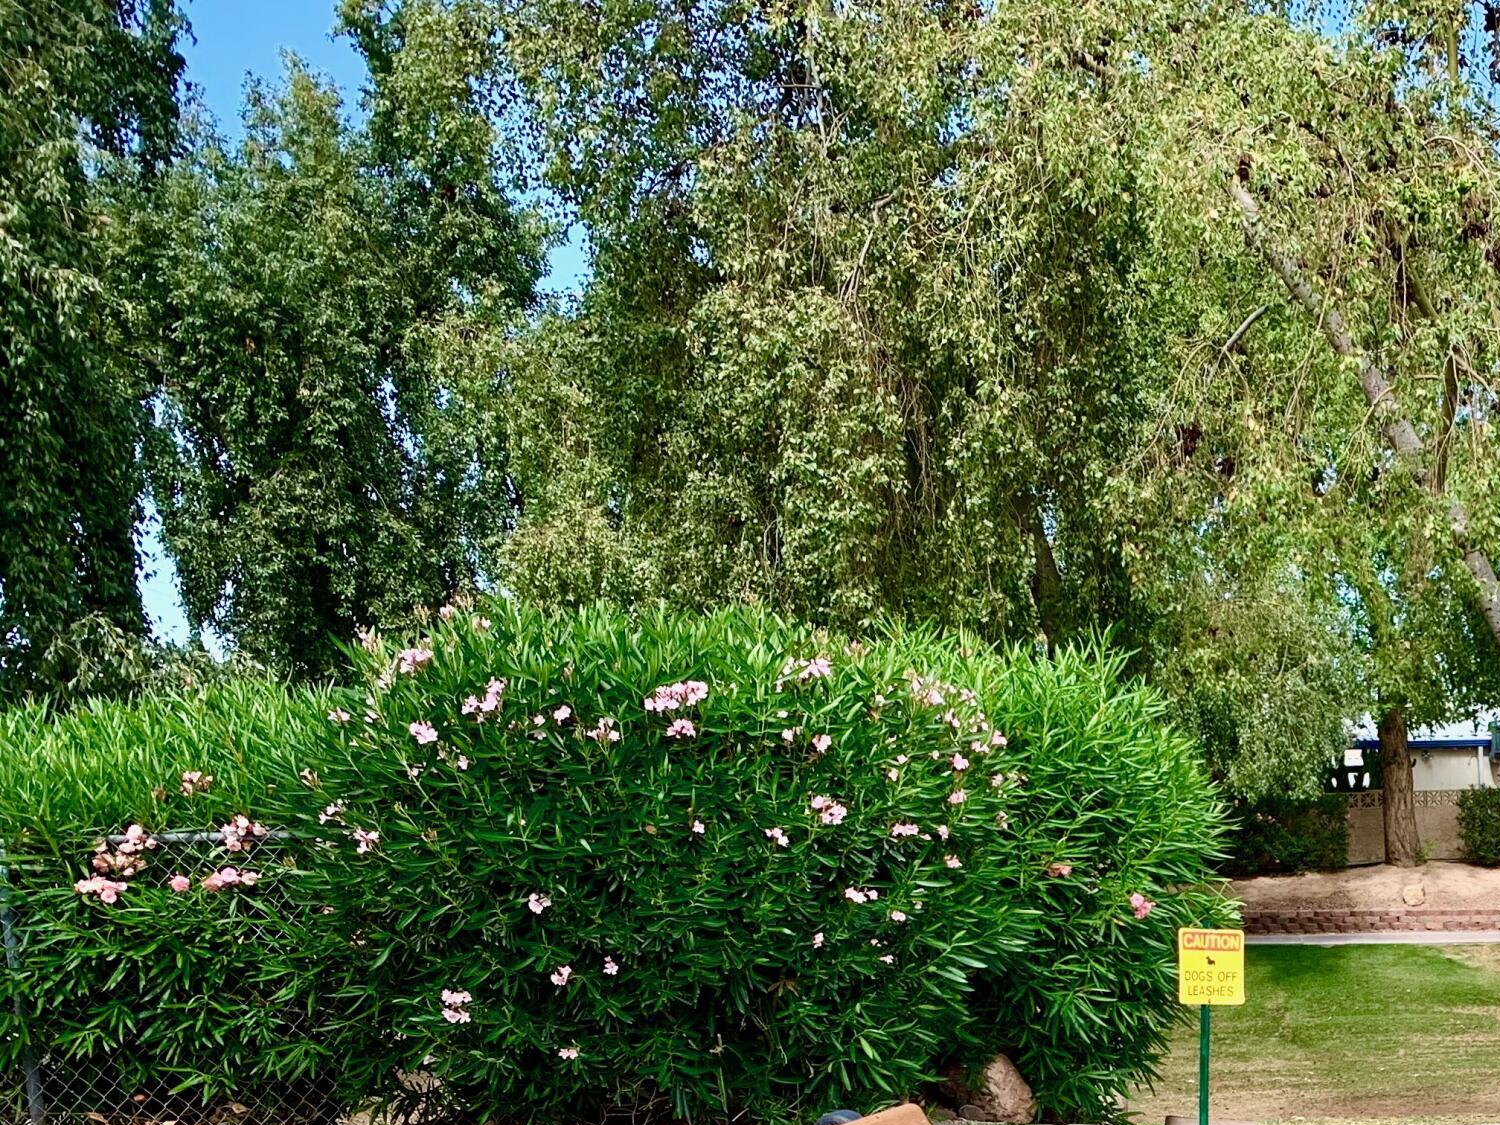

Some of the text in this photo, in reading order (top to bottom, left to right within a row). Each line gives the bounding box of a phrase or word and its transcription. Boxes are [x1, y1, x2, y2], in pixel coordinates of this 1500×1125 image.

[1183, 933, 1240, 950] CAUTION
[1184, 970, 1238, 982] DOGS OFF
[1187, 985, 1234, 997] LEASHES
